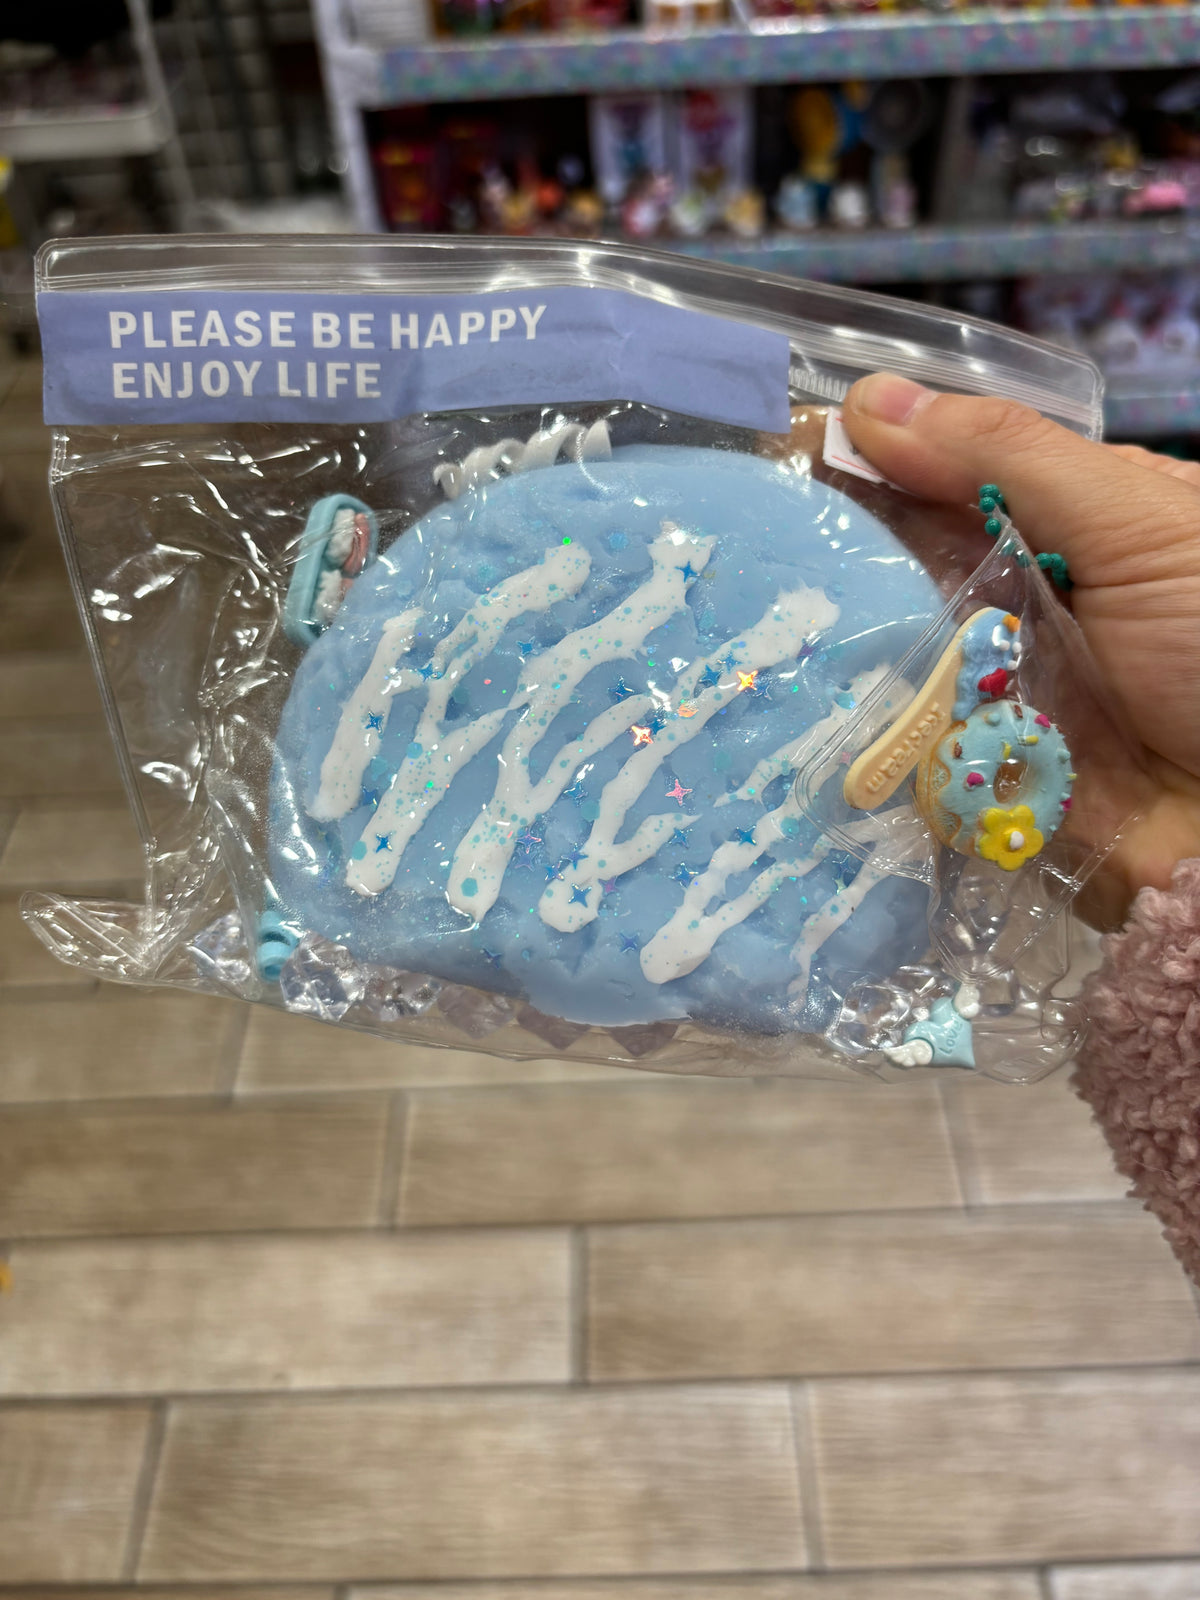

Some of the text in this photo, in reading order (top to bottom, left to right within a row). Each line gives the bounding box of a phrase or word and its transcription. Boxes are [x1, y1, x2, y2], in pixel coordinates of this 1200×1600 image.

[109, 305, 547, 349] PLEASE BE HAPPY
[113, 360, 381, 399] ENJOY LIFE
